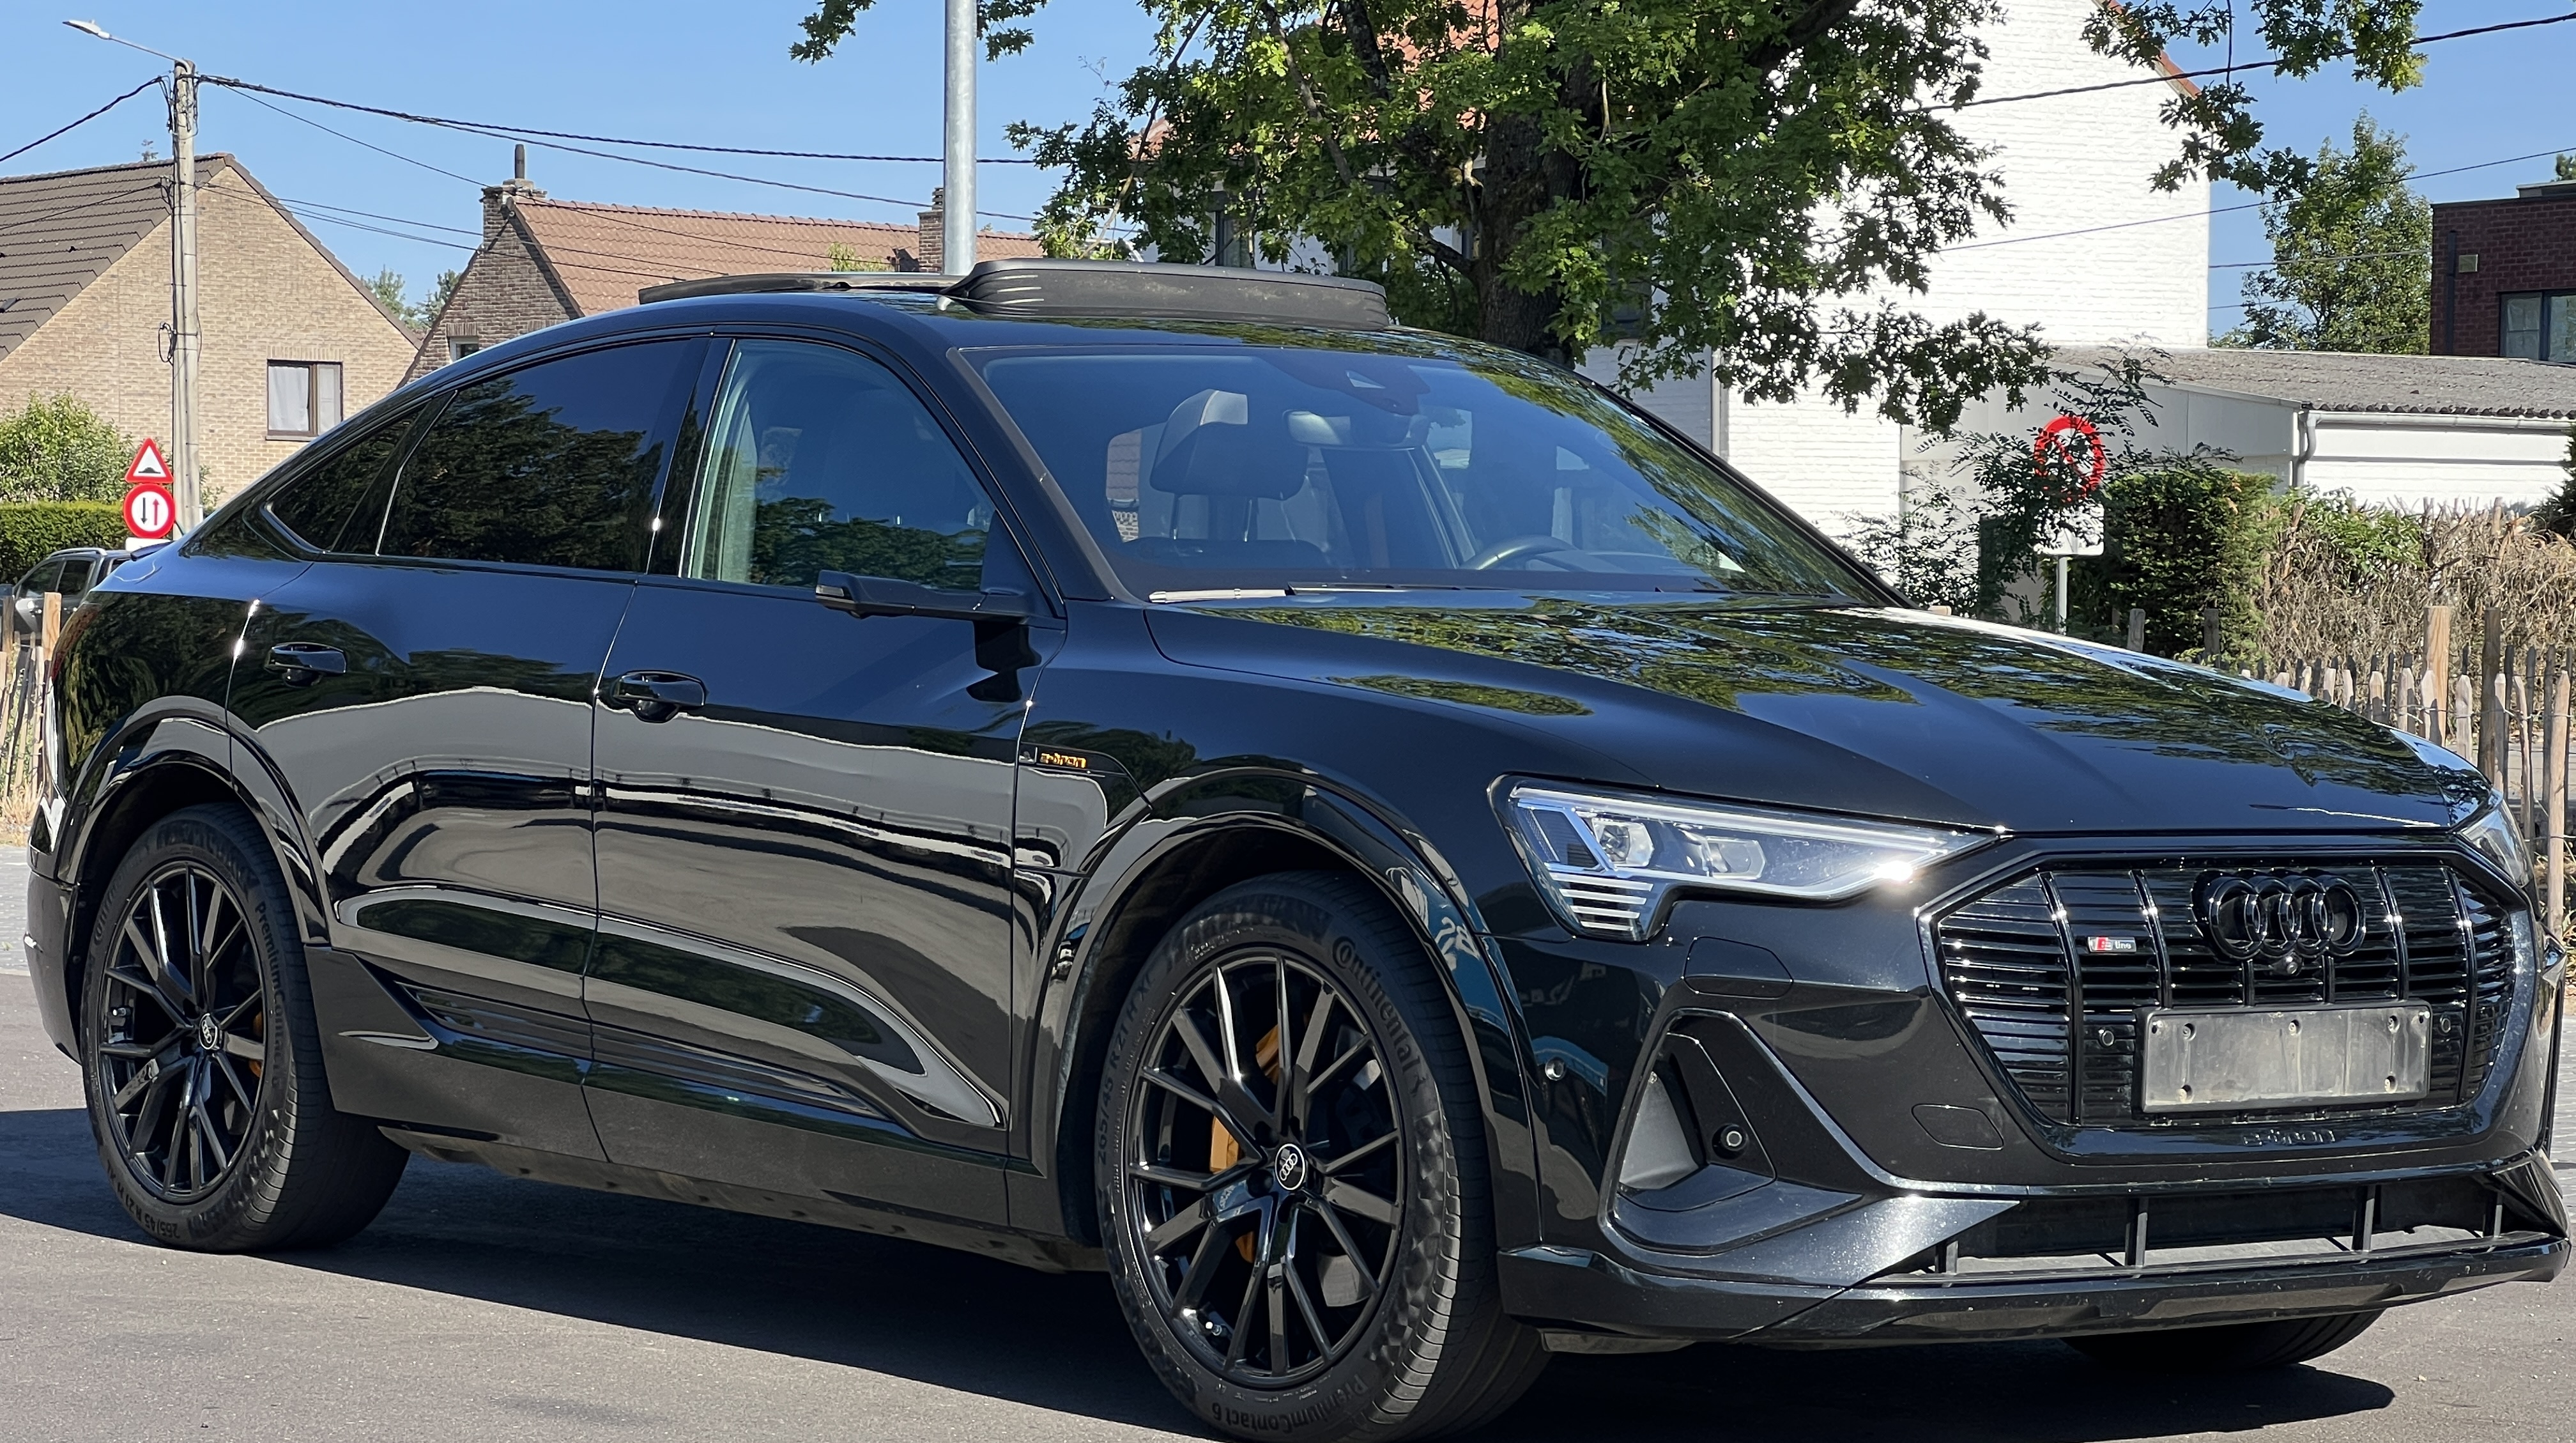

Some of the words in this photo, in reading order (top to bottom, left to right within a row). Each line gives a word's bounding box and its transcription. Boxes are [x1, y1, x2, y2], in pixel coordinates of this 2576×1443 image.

[1332, 937, 1420, 1074] Continental
[1097, 1076, 1114, 1165] 265/45
[1212, 1402, 1221, 1421] 6
[1226, 1374, 1368, 1433] PremiumContact
